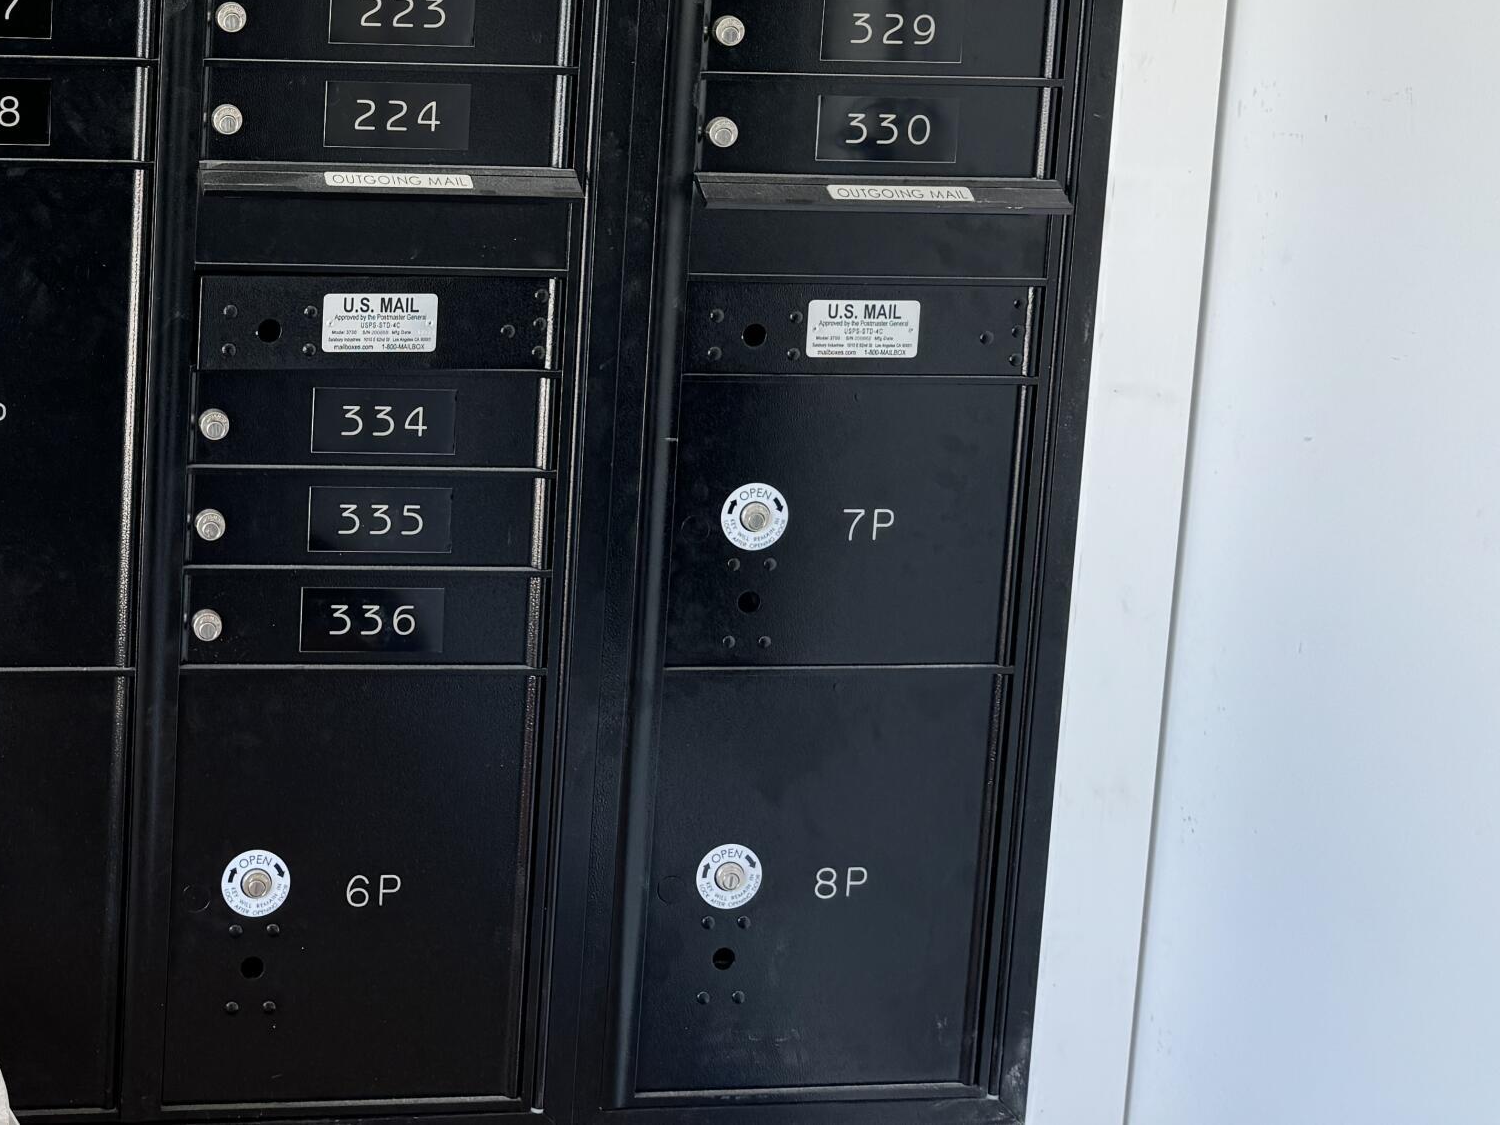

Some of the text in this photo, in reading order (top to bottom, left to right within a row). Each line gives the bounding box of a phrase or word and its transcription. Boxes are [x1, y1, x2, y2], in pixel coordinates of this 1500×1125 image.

[850, 12, 936, 45] 329
[354, 99, 441, 132] 224
[845, 113, 931, 146] 330
[332, 175, 467, 187] OUTGOING MAIL
[837, 188, 969, 200] OUTGOING MAIL
[344, 298, 419, 312] U.S. MAIL
[828, 304, 901, 319] U.S. MAIL
[340, 405, 428, 437] 334
[740, 488, 772, 500] OPEN
[337, 504, 424, 535] 335
[843, 508, 895, 541] 7P
[329, 604, 416, 636] 336
[239, 855, 273, 868] OPEN
[712, 848, 743, 863] OPEN
[346, 874, 402, 908] 6P
[814, 866, 868, 900] 8P
